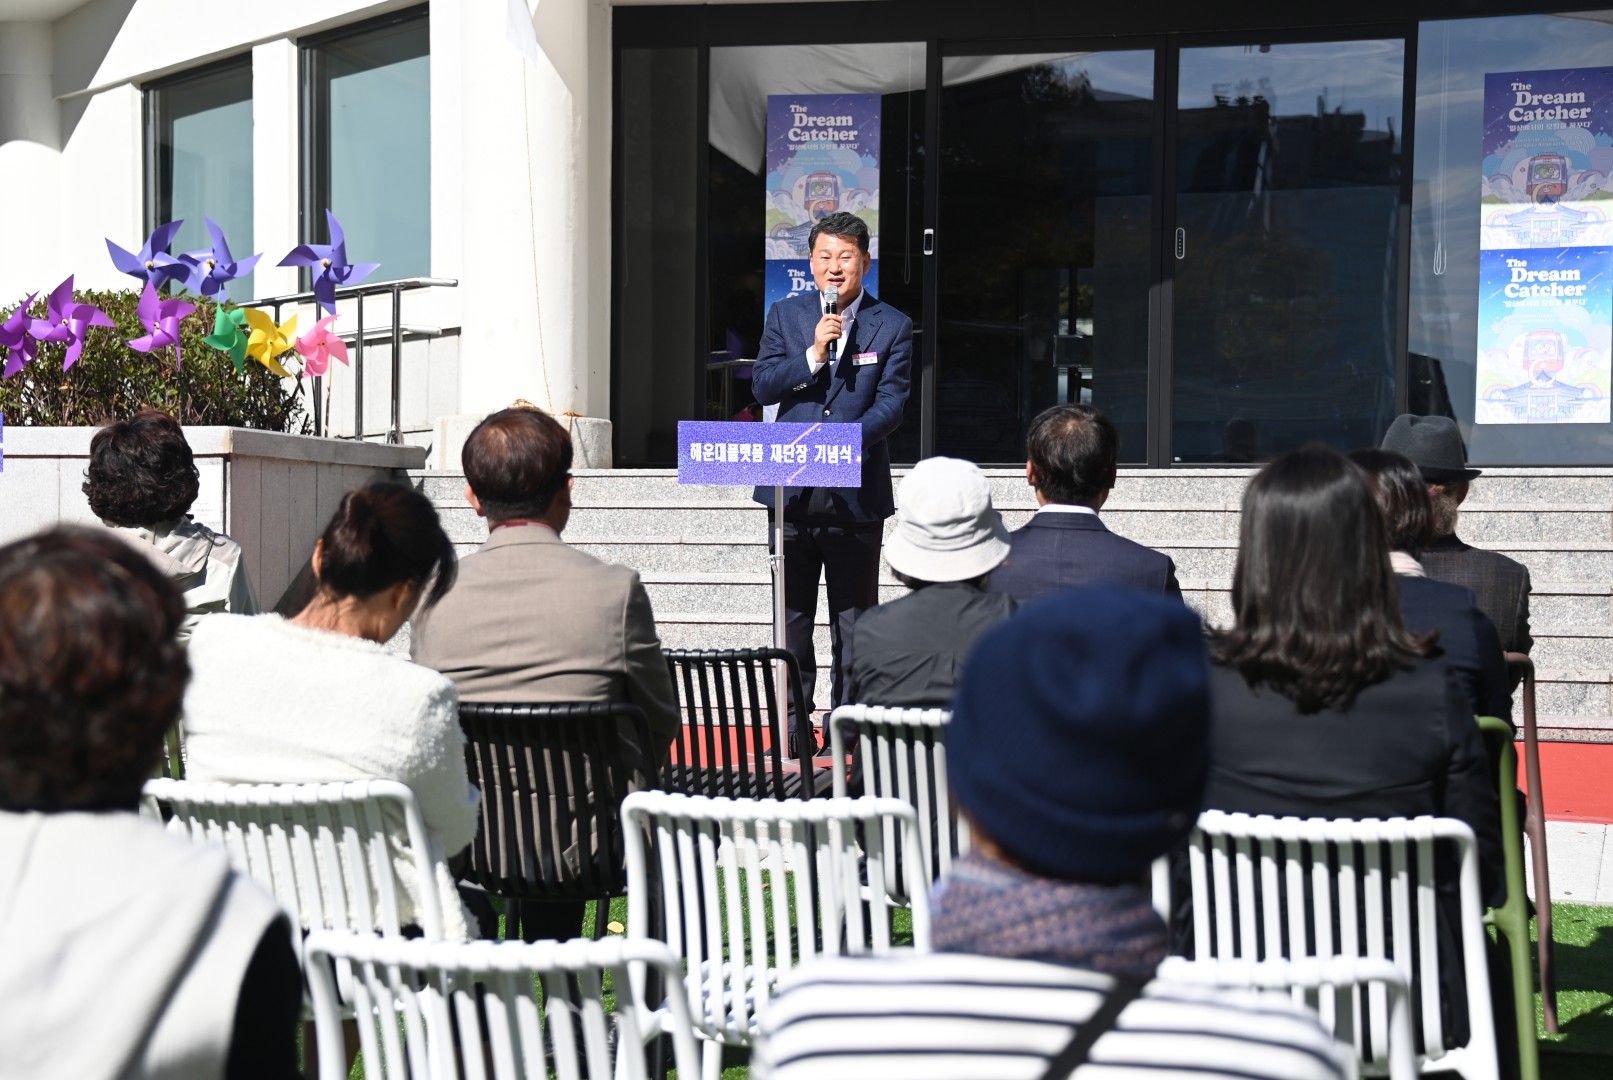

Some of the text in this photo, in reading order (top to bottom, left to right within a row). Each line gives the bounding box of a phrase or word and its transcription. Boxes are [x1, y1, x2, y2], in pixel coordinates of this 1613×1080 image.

[1510, 82, 1532, 91] The
[1515, 91, 1585, 106] Dream
[789, 104, 808, 113] The
[1508, 105, 1592, 122] Catcher
[793, 113, 853, 127] Dream
[788, 127, 858, 142] Catcher
[1505, 258, 1528, 267] The
[787, 268, 806, 277] The
[1510, 267, 1581, 282] Dream
[1504, 282, 1587, 298] Catcher
[690, 442, 852, 464] 해운대플랫폼 재단장 기념식
